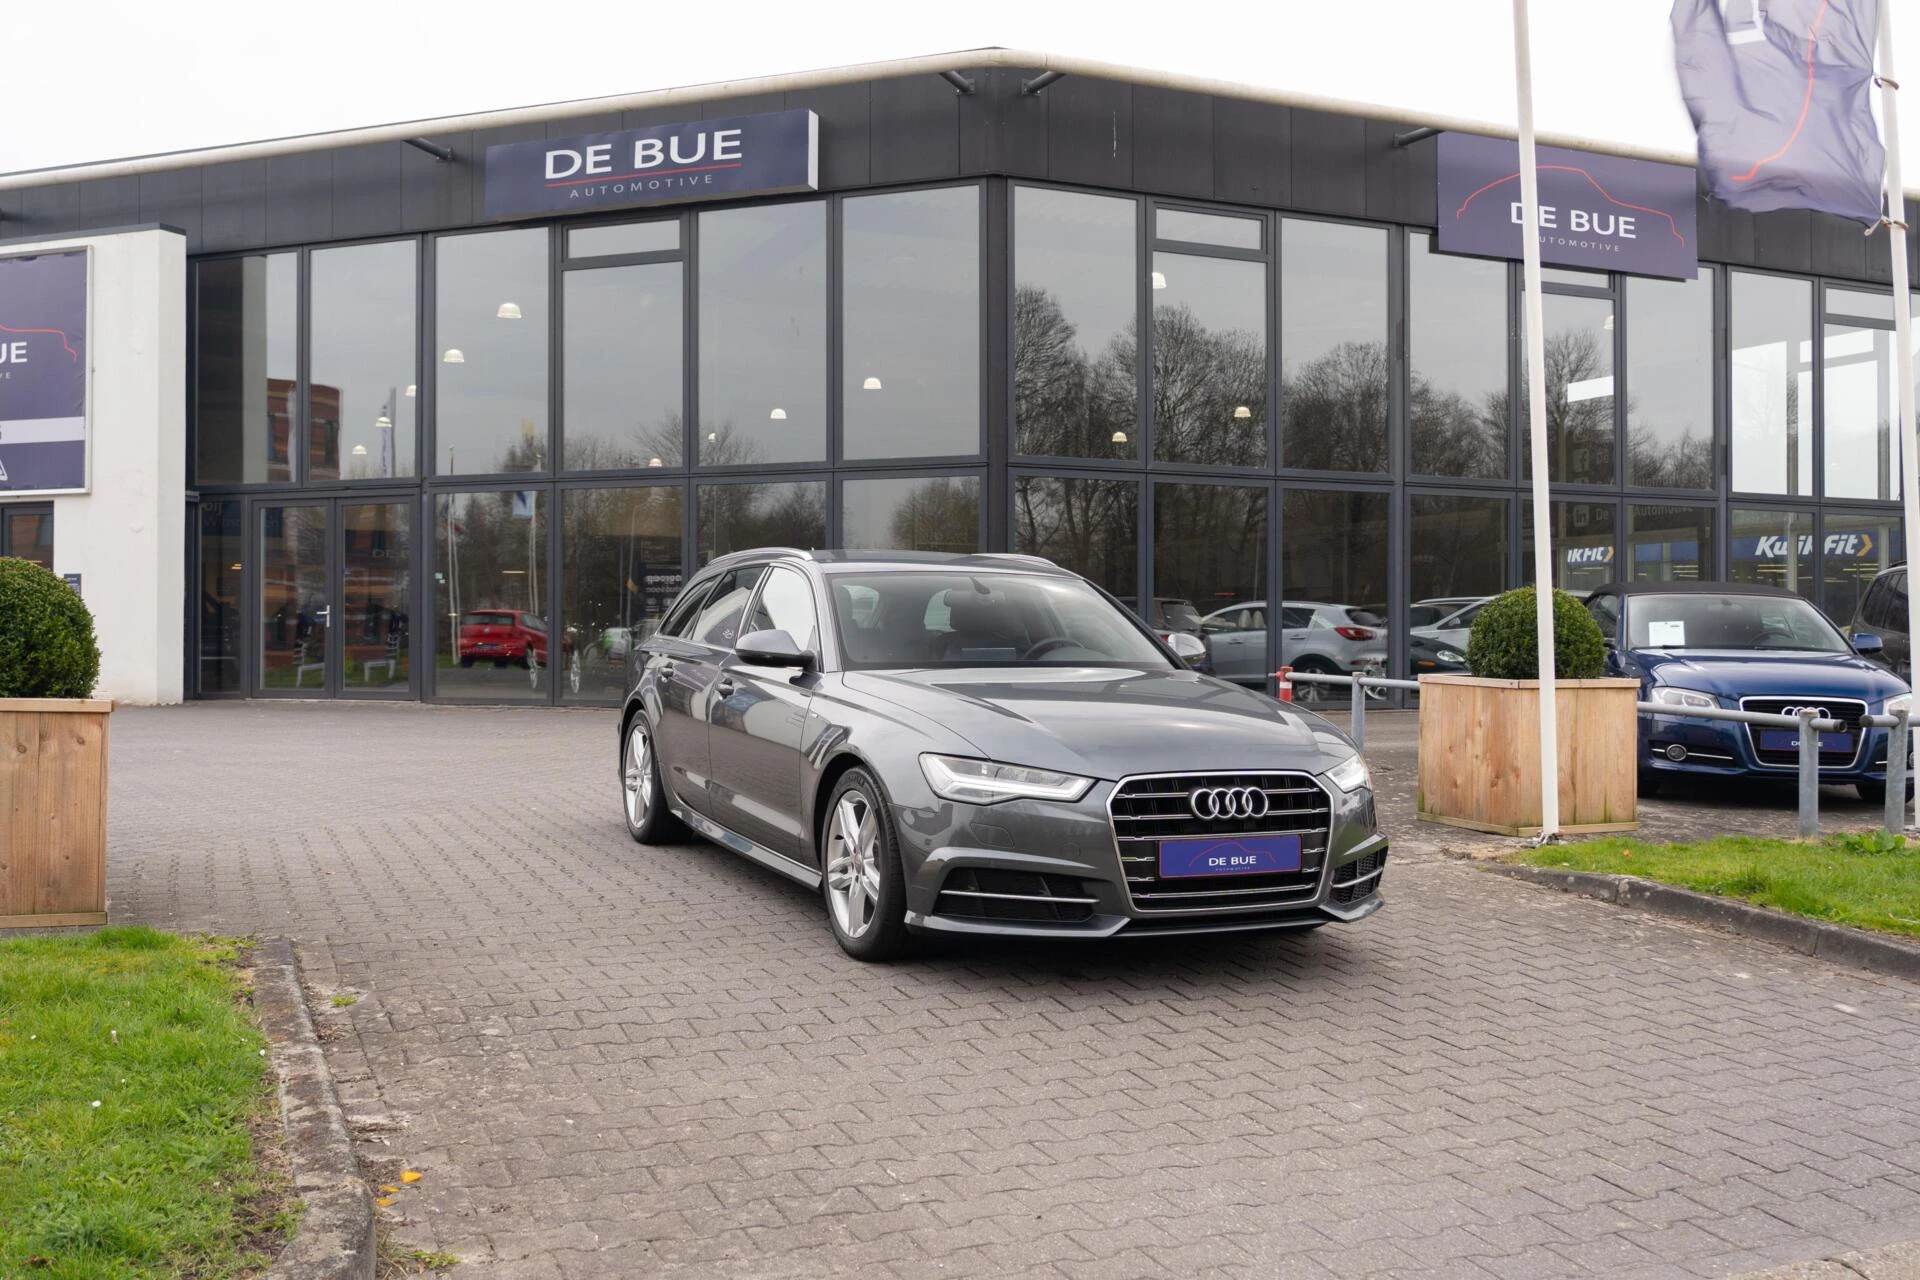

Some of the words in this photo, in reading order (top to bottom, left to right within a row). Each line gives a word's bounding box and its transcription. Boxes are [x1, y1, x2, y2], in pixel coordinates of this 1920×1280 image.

[544, 143, 612, 180] DE
[633, 128, 743, 169] BUE
[569, 174, 712, 198] AUTOMOTIVE
[1570, 209, 1636, 239] BUE
[1538, 235, 1620, 252] UTOMOTIVE
[1824, 534, 1858, 555] Fit
[1209, 857, 1227, 866] DE
[1231, 856, 1257, 865] BUE
